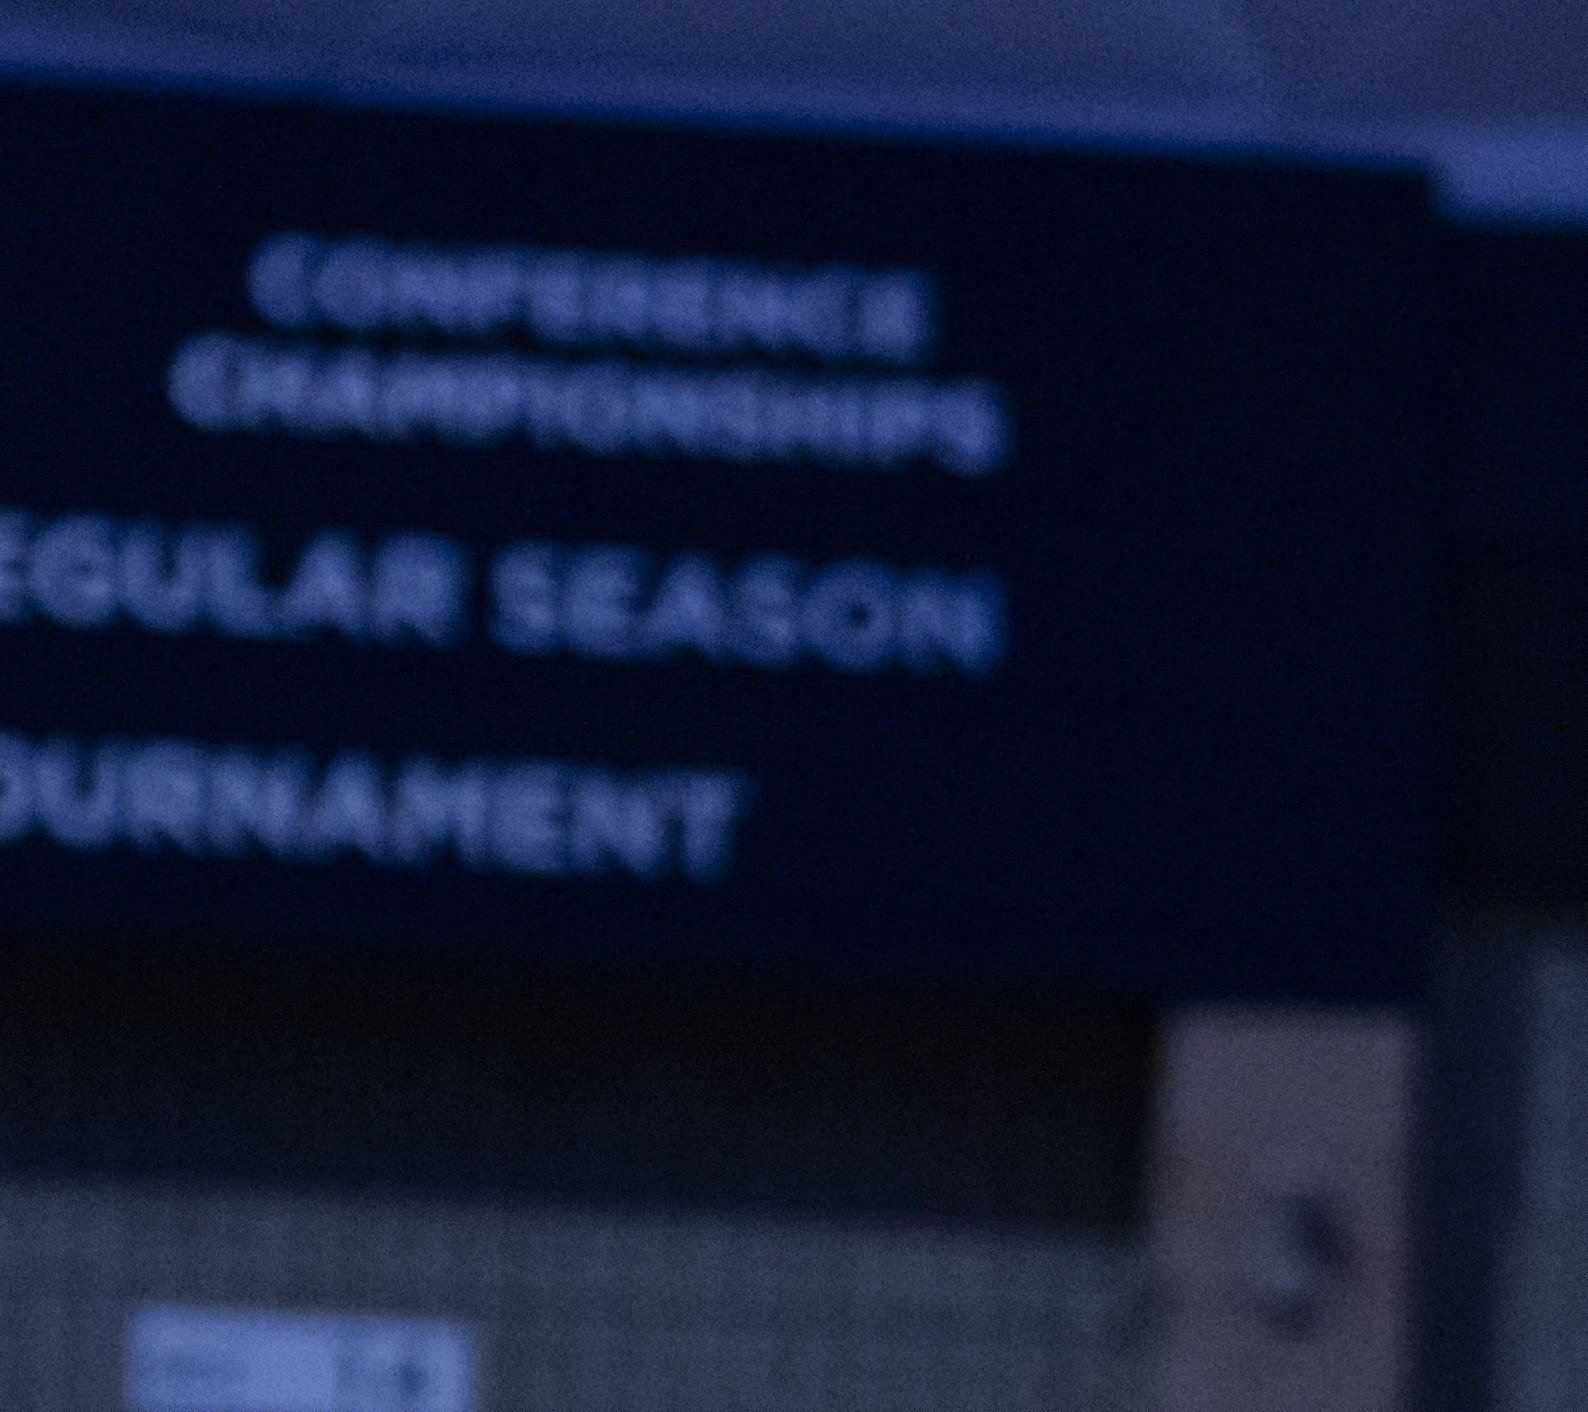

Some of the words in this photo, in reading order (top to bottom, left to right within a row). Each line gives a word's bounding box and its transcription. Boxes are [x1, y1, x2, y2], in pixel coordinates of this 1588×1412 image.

[248, 234, 934, 361] CONFERENCE
[171, 334, 1004, 474] CHAMPIONSHIPS
[490, 540, 1002, 672] SEASON
